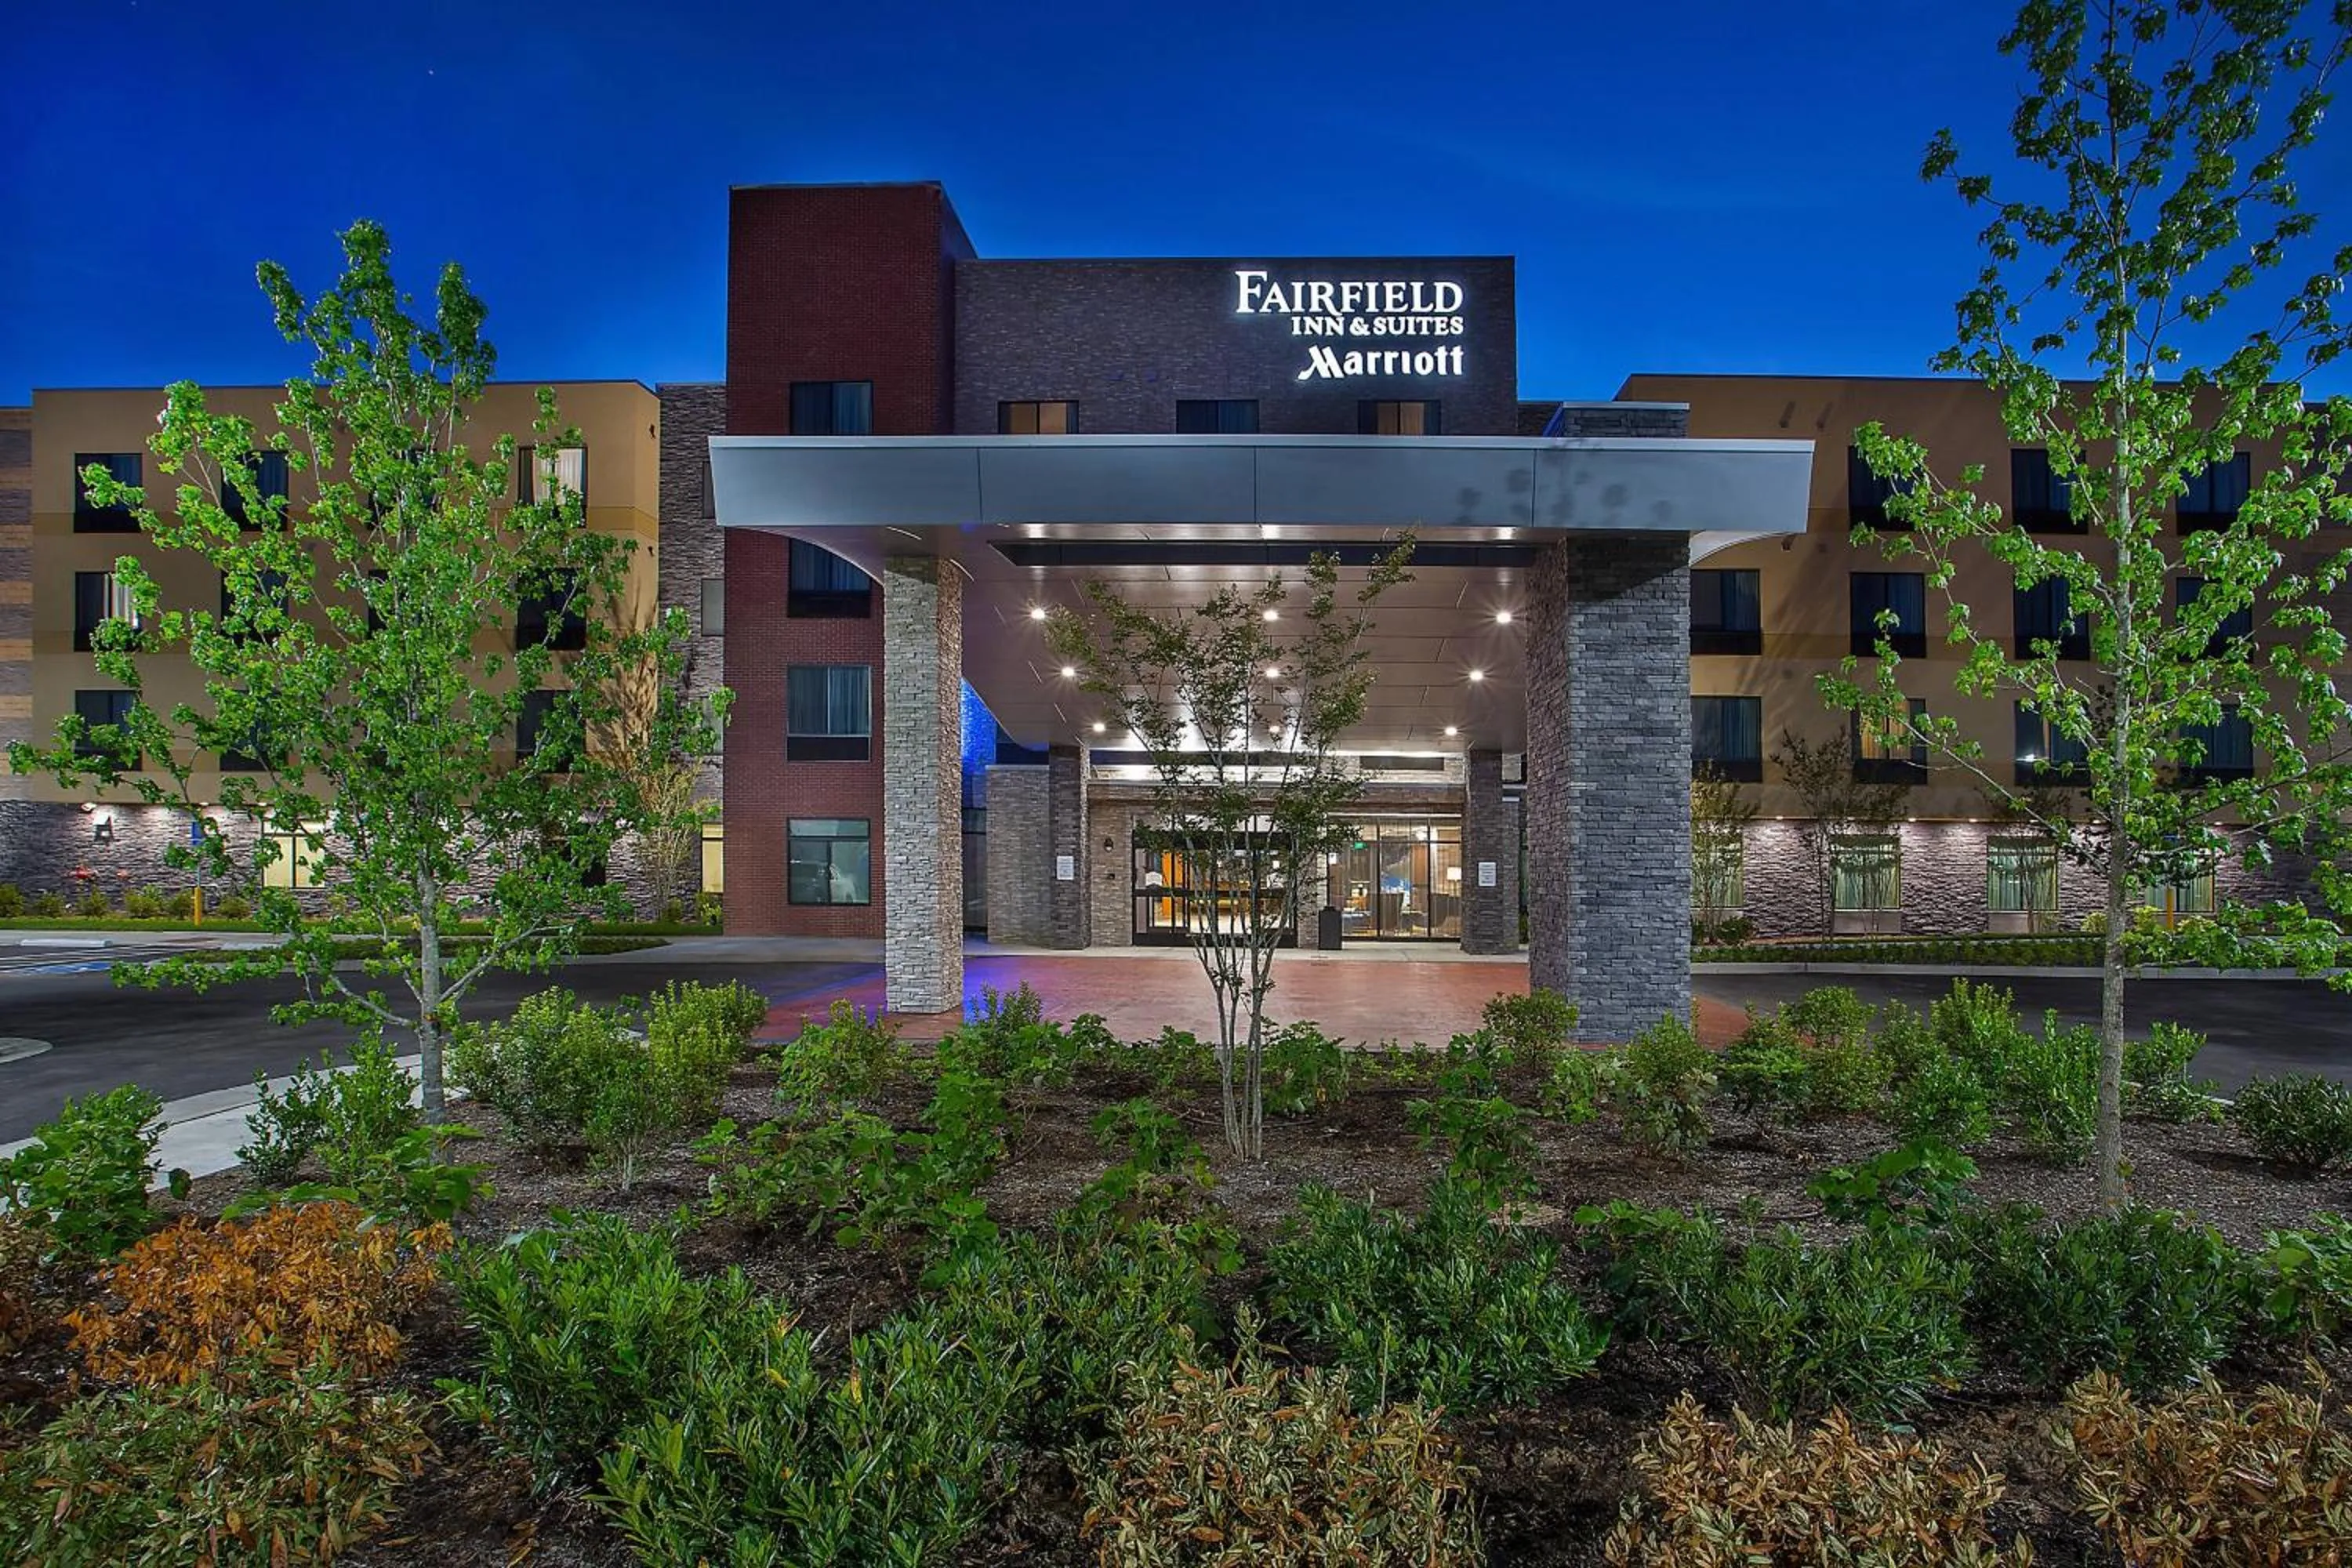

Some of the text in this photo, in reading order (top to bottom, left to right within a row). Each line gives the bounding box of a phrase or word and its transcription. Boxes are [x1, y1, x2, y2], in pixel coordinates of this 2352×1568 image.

[1235, 270, 1463, 316] FAIRFIELD
[1291, 316, 1464, 336] INN & SUITES
[1298, 345, 1464, 380] Marriott
